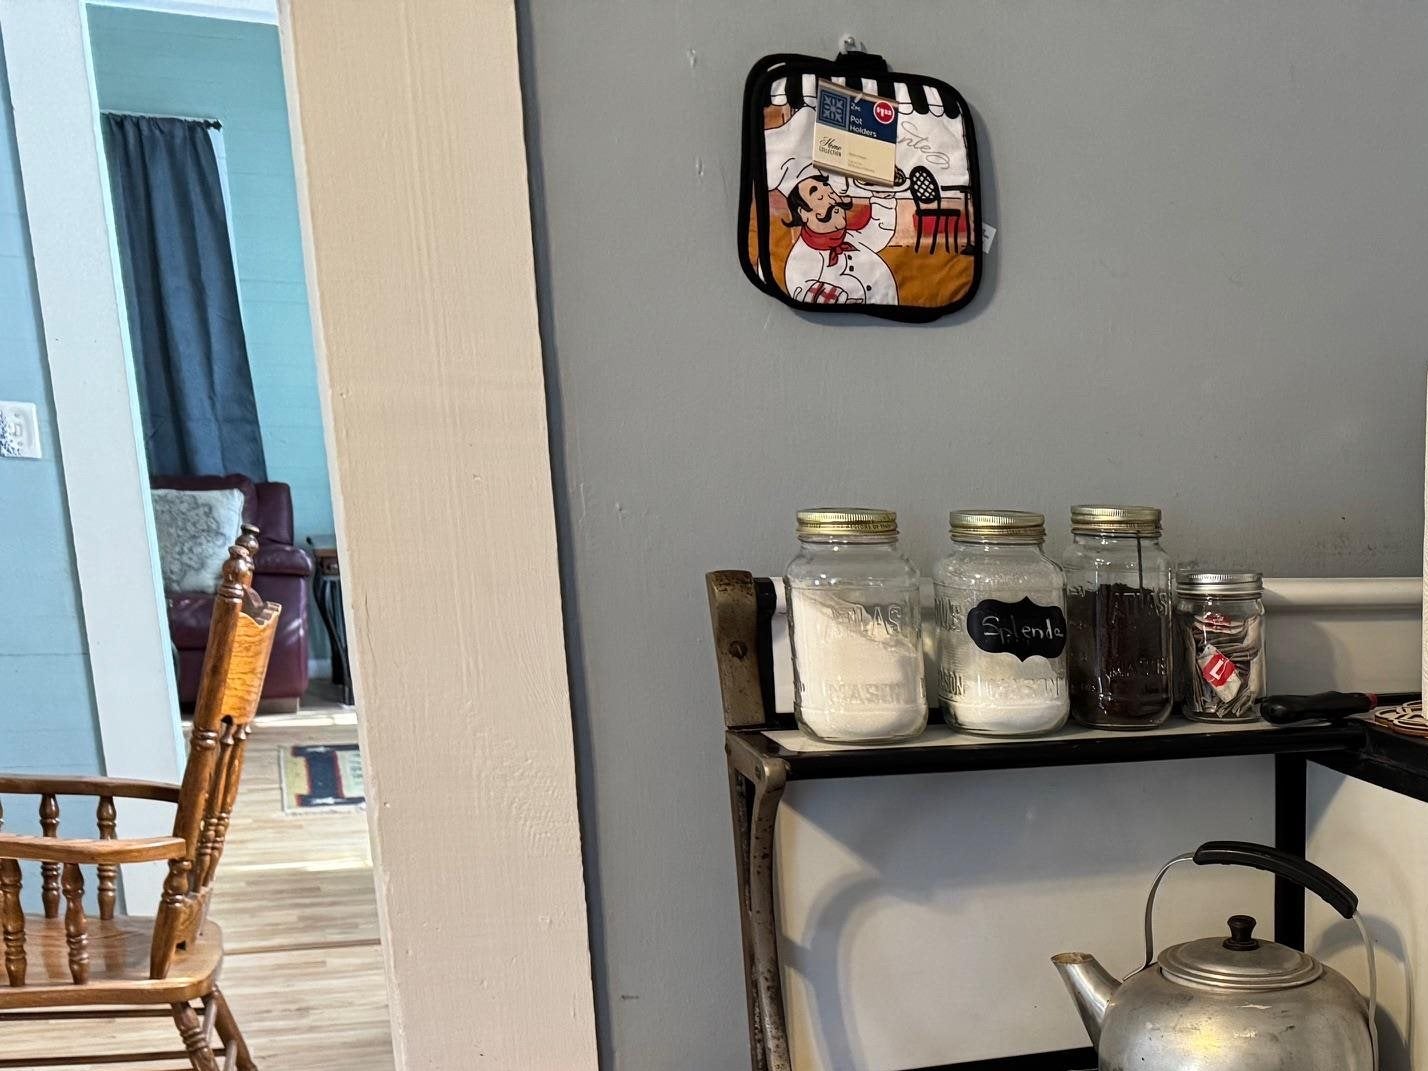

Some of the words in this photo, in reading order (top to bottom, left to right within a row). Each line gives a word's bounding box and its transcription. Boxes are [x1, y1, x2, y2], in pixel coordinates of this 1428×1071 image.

[850, 115, 863, 125] Pot
[849, 125, 877, 137] Holders
[981, 614, 1064, 646] Splenda
